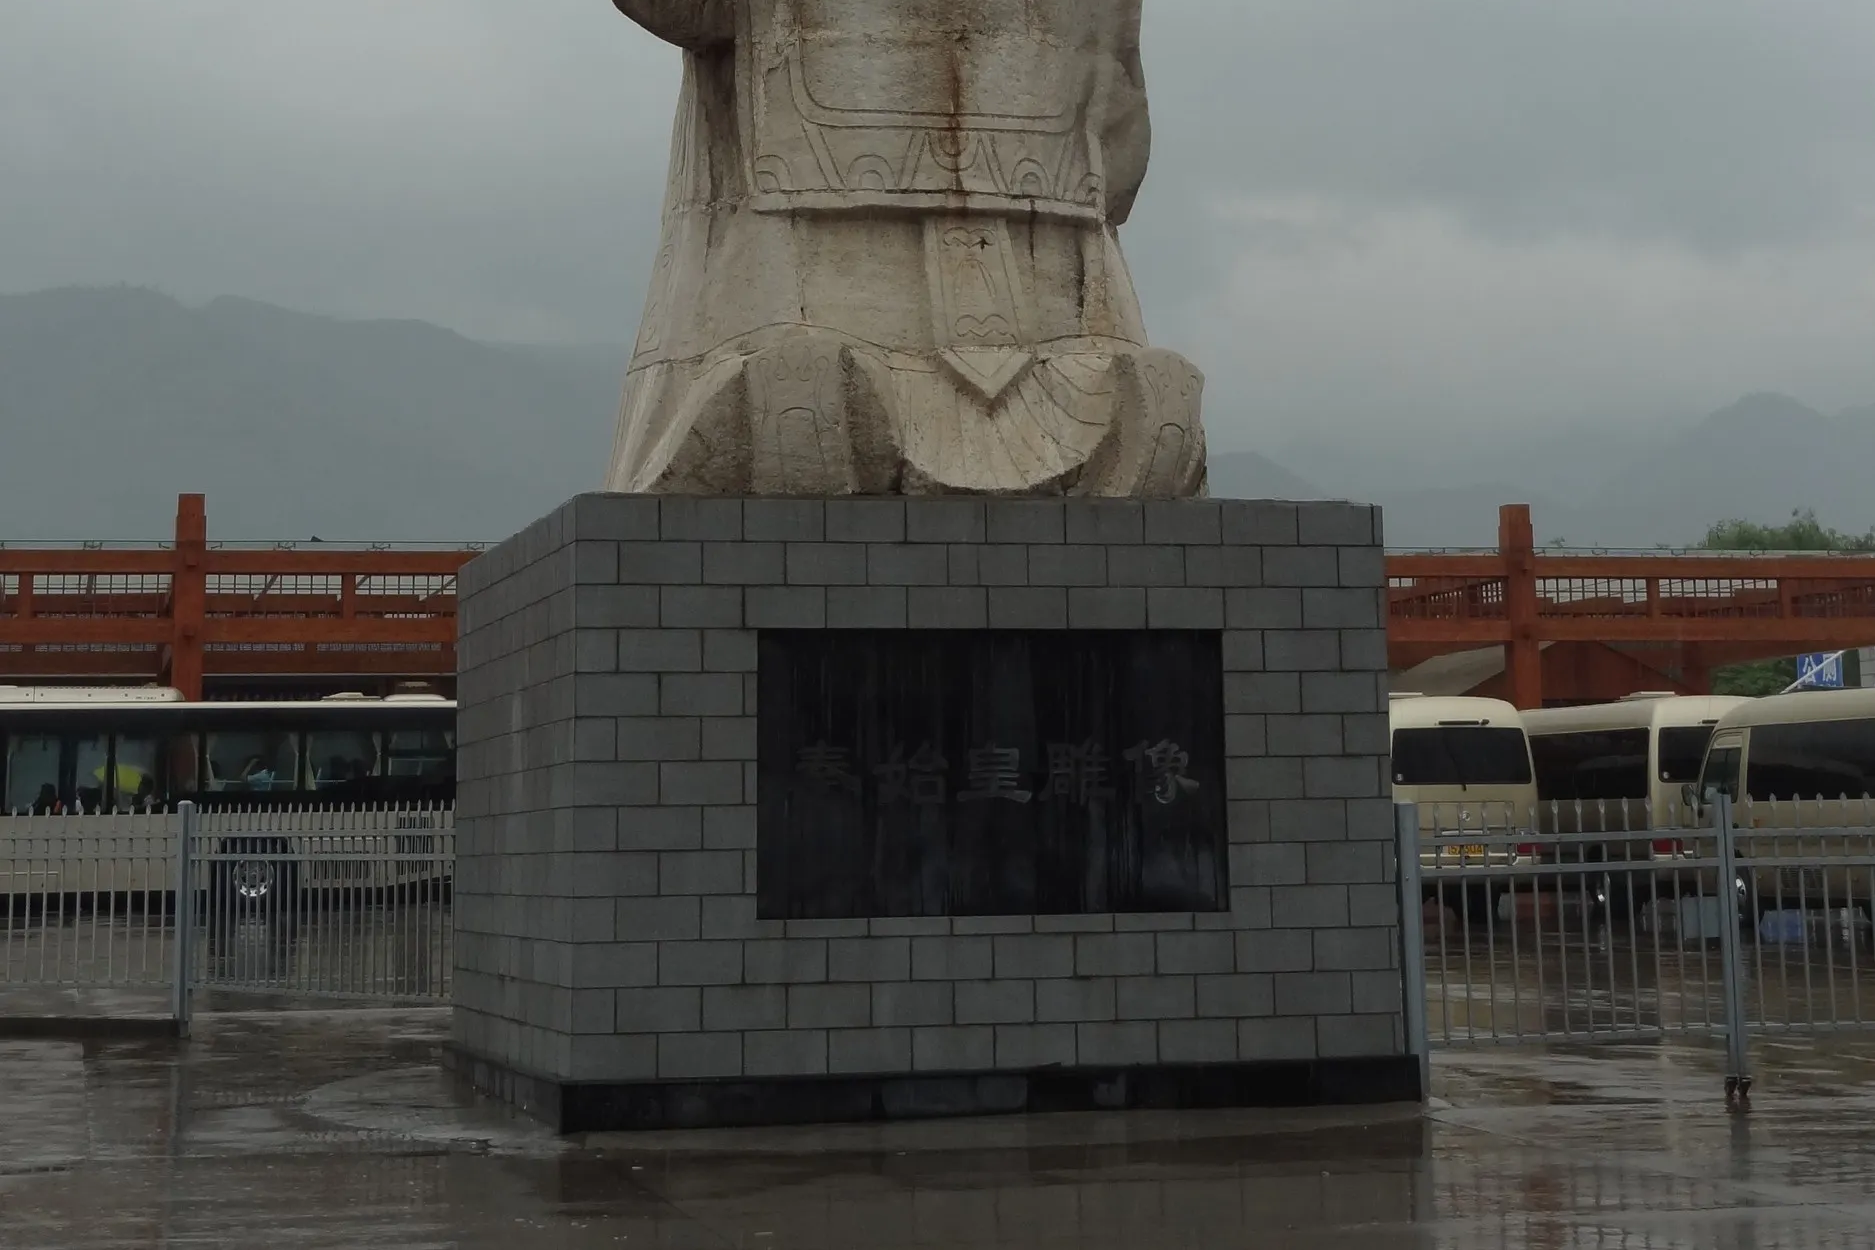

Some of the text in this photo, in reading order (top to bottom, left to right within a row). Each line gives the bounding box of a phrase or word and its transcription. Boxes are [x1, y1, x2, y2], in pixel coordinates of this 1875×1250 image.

[795, 739, 1200, 805] 秦始皇雕像
